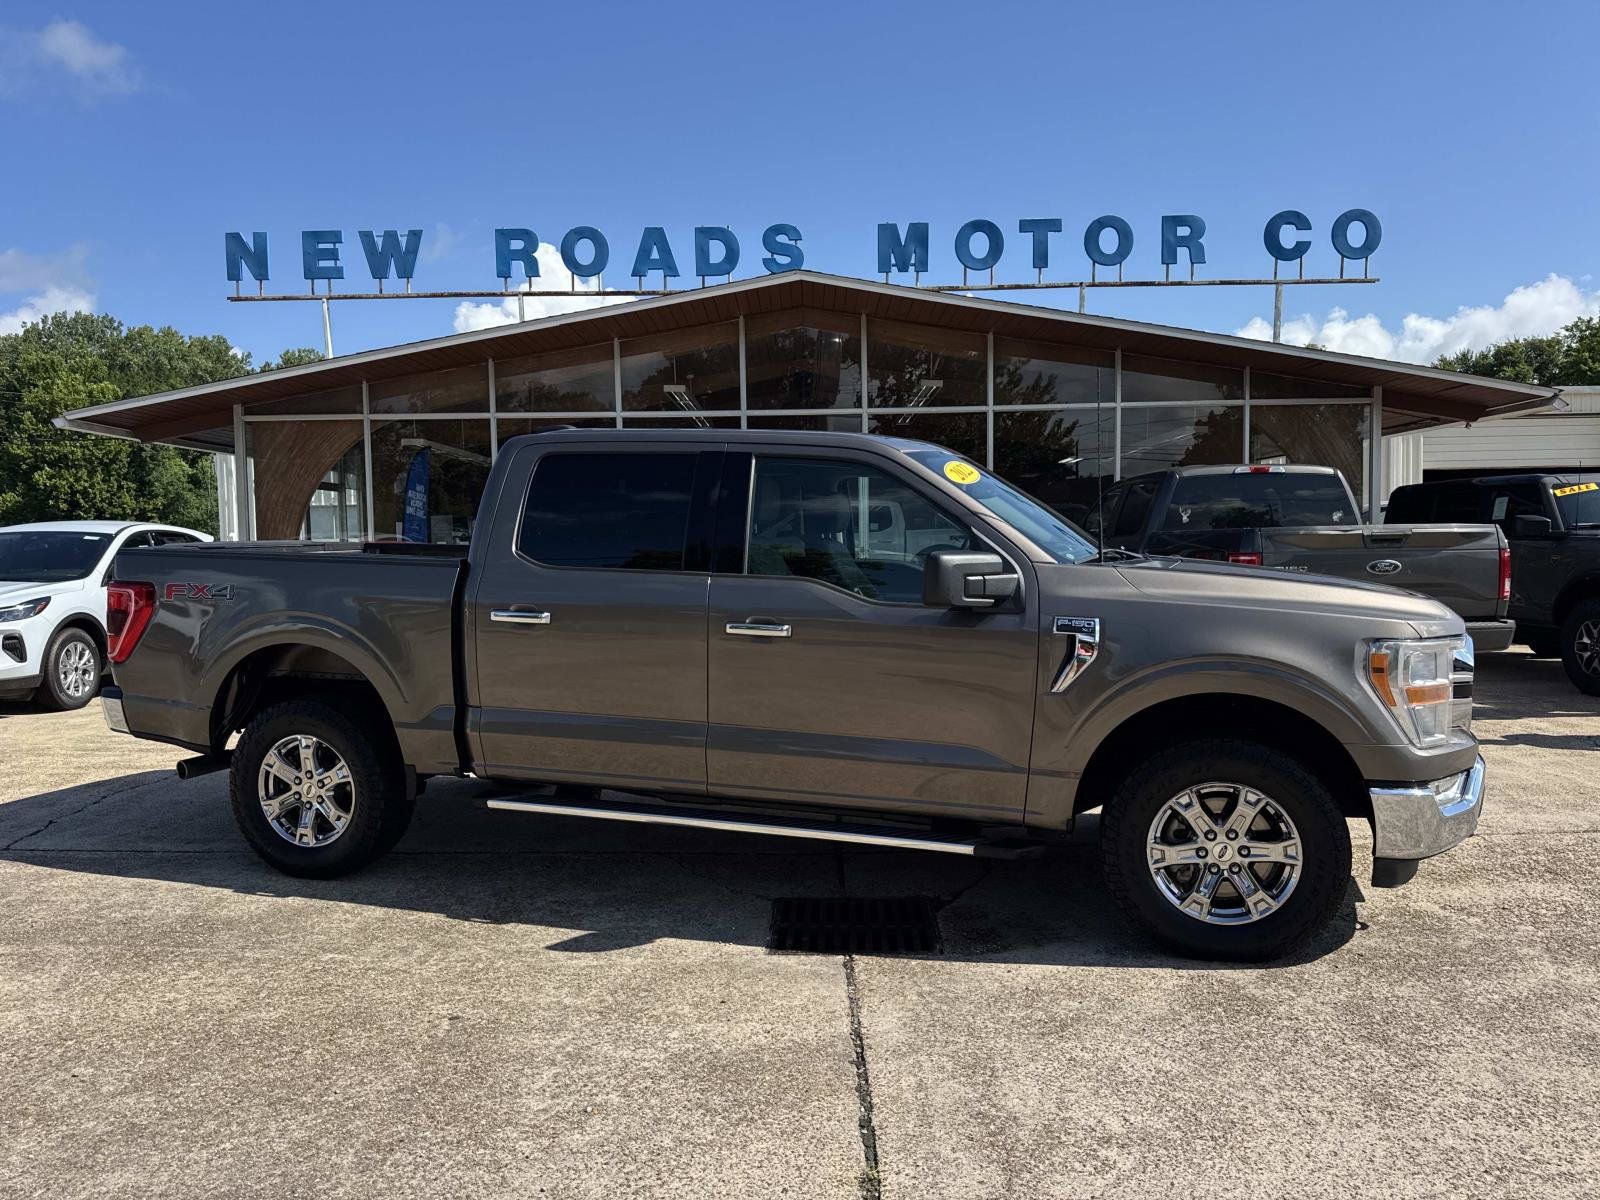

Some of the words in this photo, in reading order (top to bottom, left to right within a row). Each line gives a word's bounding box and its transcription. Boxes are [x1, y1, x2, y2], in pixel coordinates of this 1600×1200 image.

[225, 229, 424, 281] NEW
[494, 223, 805, 279] ROADS
[877, 214, 1207, 273] MOTOR
[1263, 208, 1383, 261] CO
[1559, 484, 1592, 495] SALE
[164, 582, 236, 602] FX4
[1057, 619, 1095, 628] F-150
